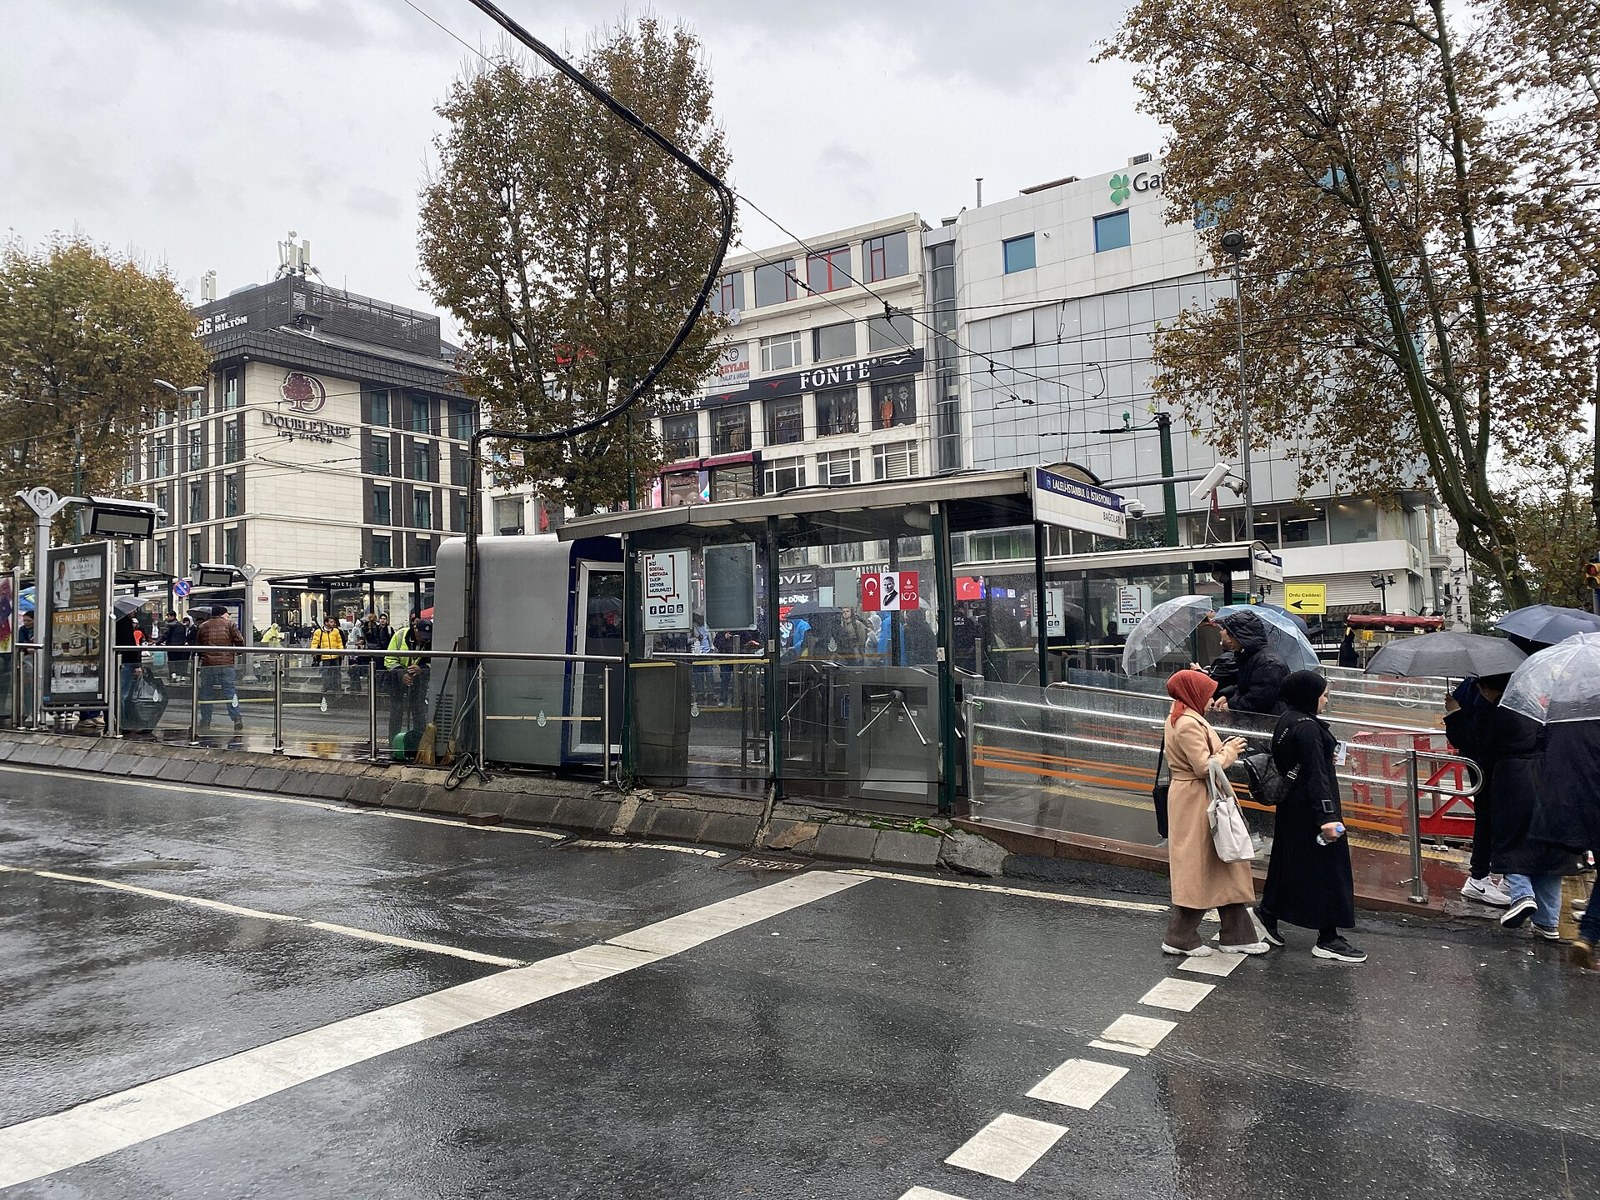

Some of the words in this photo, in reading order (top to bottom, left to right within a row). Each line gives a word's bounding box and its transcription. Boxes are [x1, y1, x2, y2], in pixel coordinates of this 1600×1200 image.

[214, 312, 227, 323] BY
[214, 315, 248, 332] HILTON
[799, 360, 871, 390] FONTE
